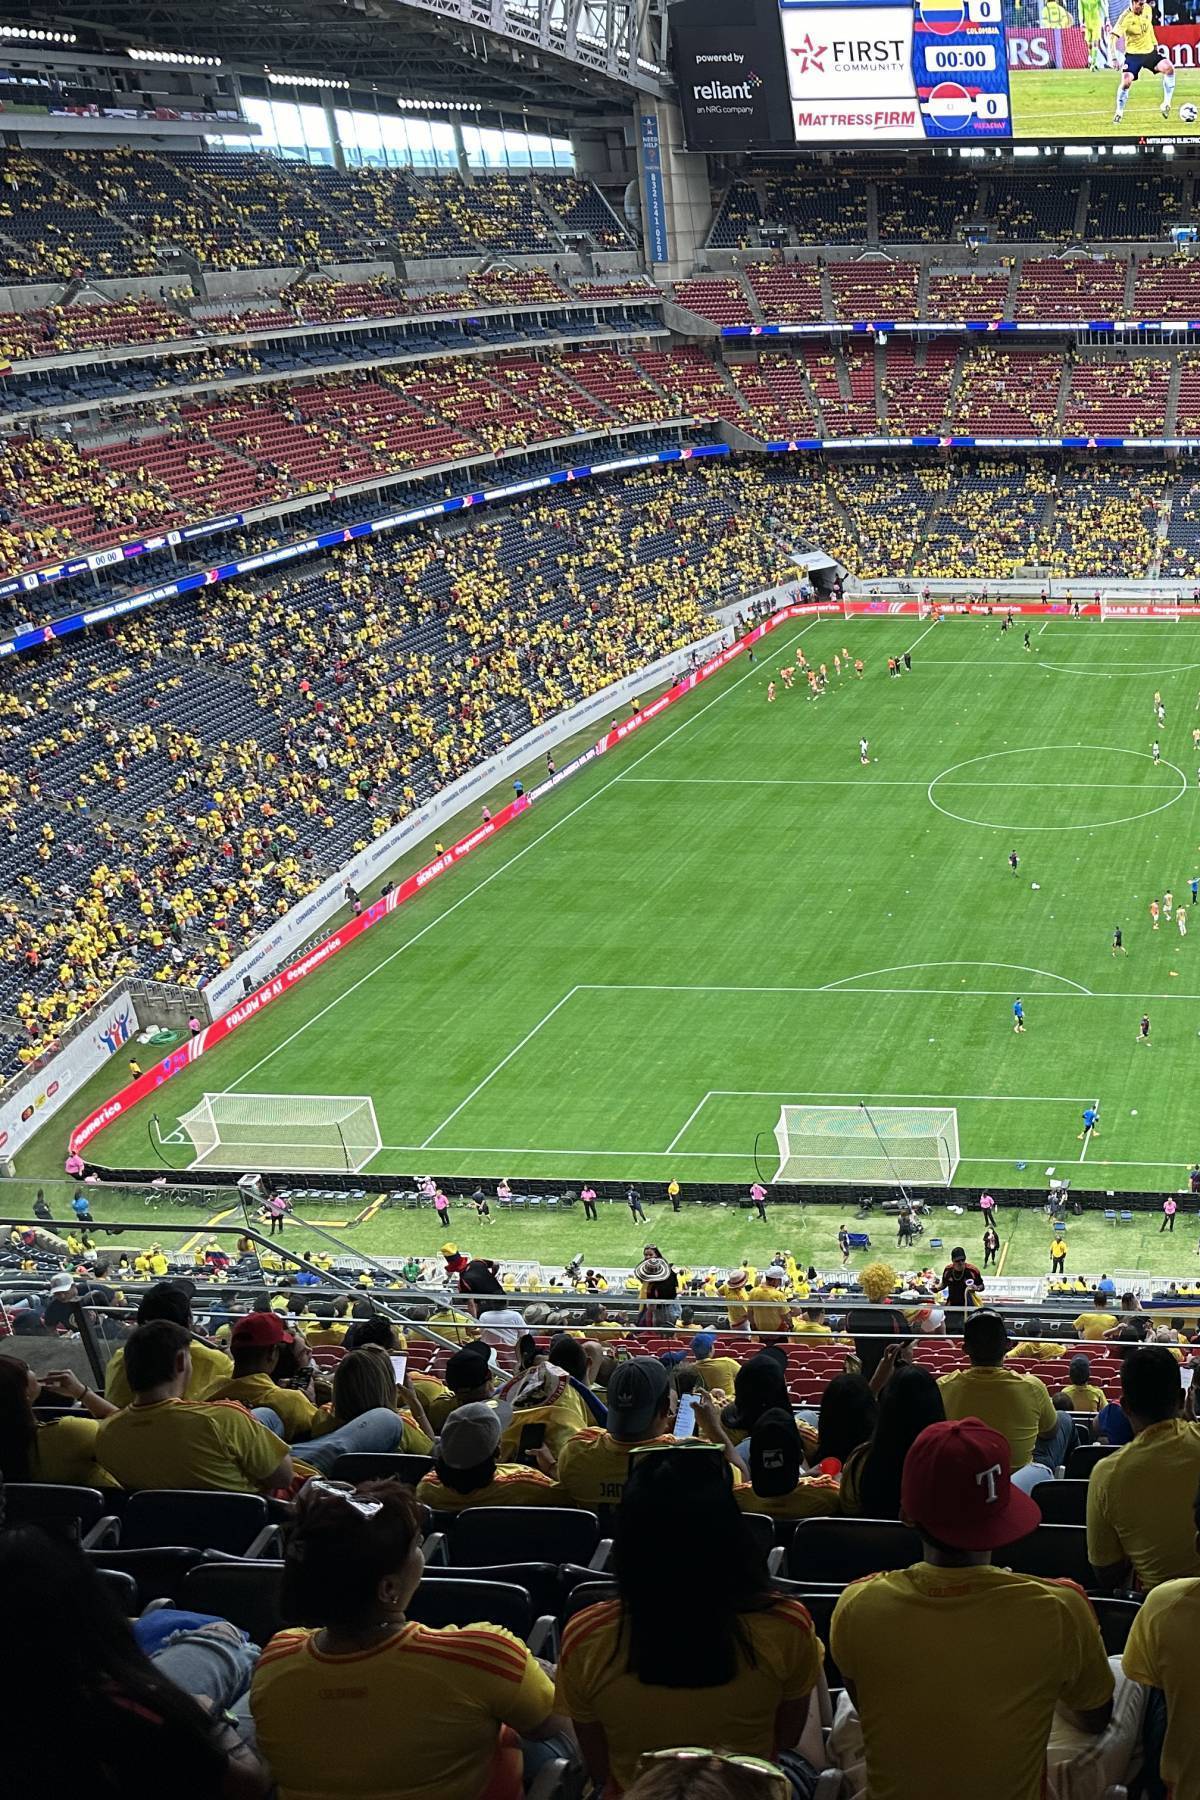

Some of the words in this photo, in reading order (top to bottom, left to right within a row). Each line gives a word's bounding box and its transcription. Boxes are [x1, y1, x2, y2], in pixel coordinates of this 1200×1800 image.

[696, 52, 733, 64] powered
[733, 52, 744, 63] by
[833, 40, 904, 62] FIRST
[936, 50, 986, 67] 00:00
[834, 63, 904, 72] COMMUNITY
[693, 81, 752, 100] reliant
[705, 105, 722, 113] NRG
[722, 106, 753, 115] company
[986, 99, 997, 114] 0
[212, 976, 237, 1002] CONMEBOL
[226, 996, 260, 1029] FOLLOW
[976, 1464, 1001, 1503] T
